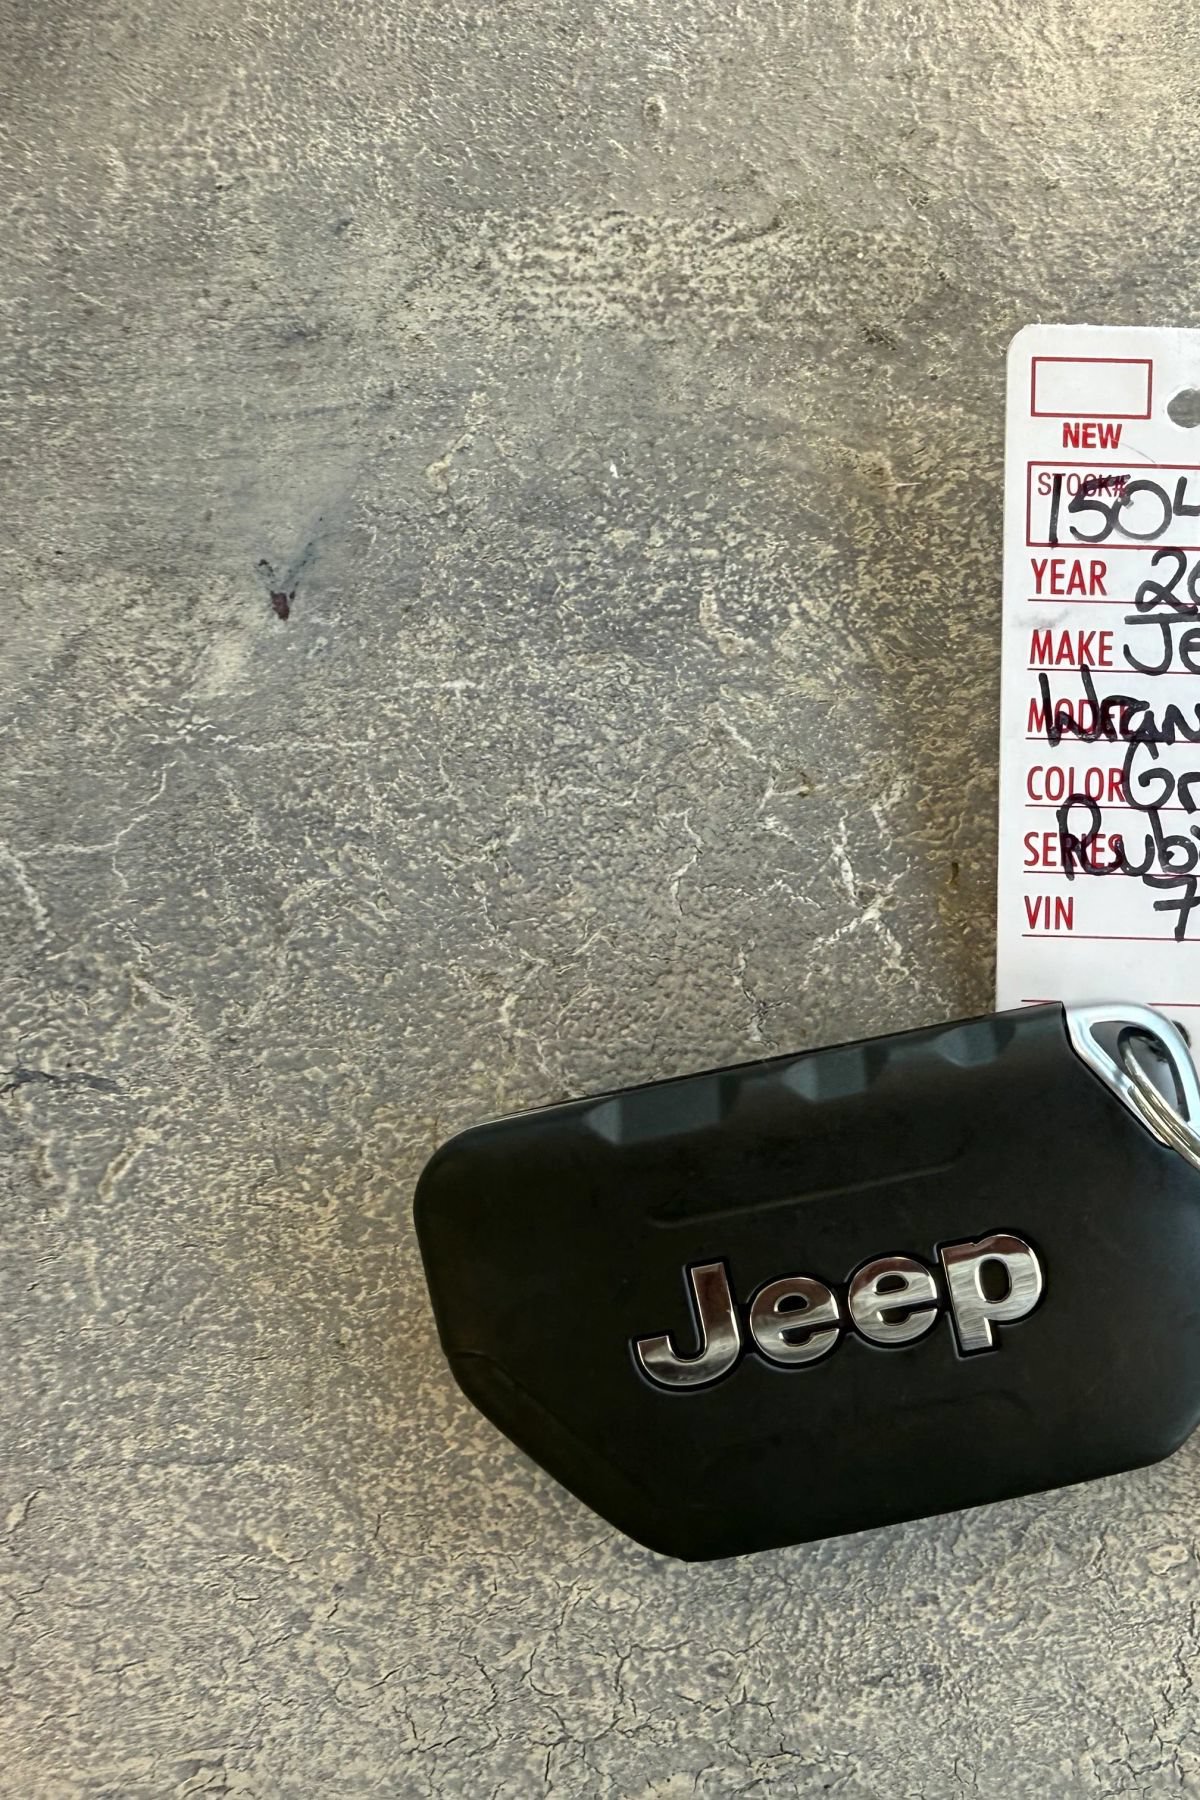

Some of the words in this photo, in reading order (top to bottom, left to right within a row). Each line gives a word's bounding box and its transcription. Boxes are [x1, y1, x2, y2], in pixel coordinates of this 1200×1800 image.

[1062, 422, 1123, 449] NEW
[1037, 471, 1126, 498] STOCK#
[1030, 558, 1108, 596] YEAR
[1029, 629, 1115, 667] MAKE
[1026, 765, 1126, 803] COLOR
[1024, 831, 1124, 868] SERIES
[1024, 896, 1075, 931] VIN
[634, 1231, 1044, 1390] Jeep
